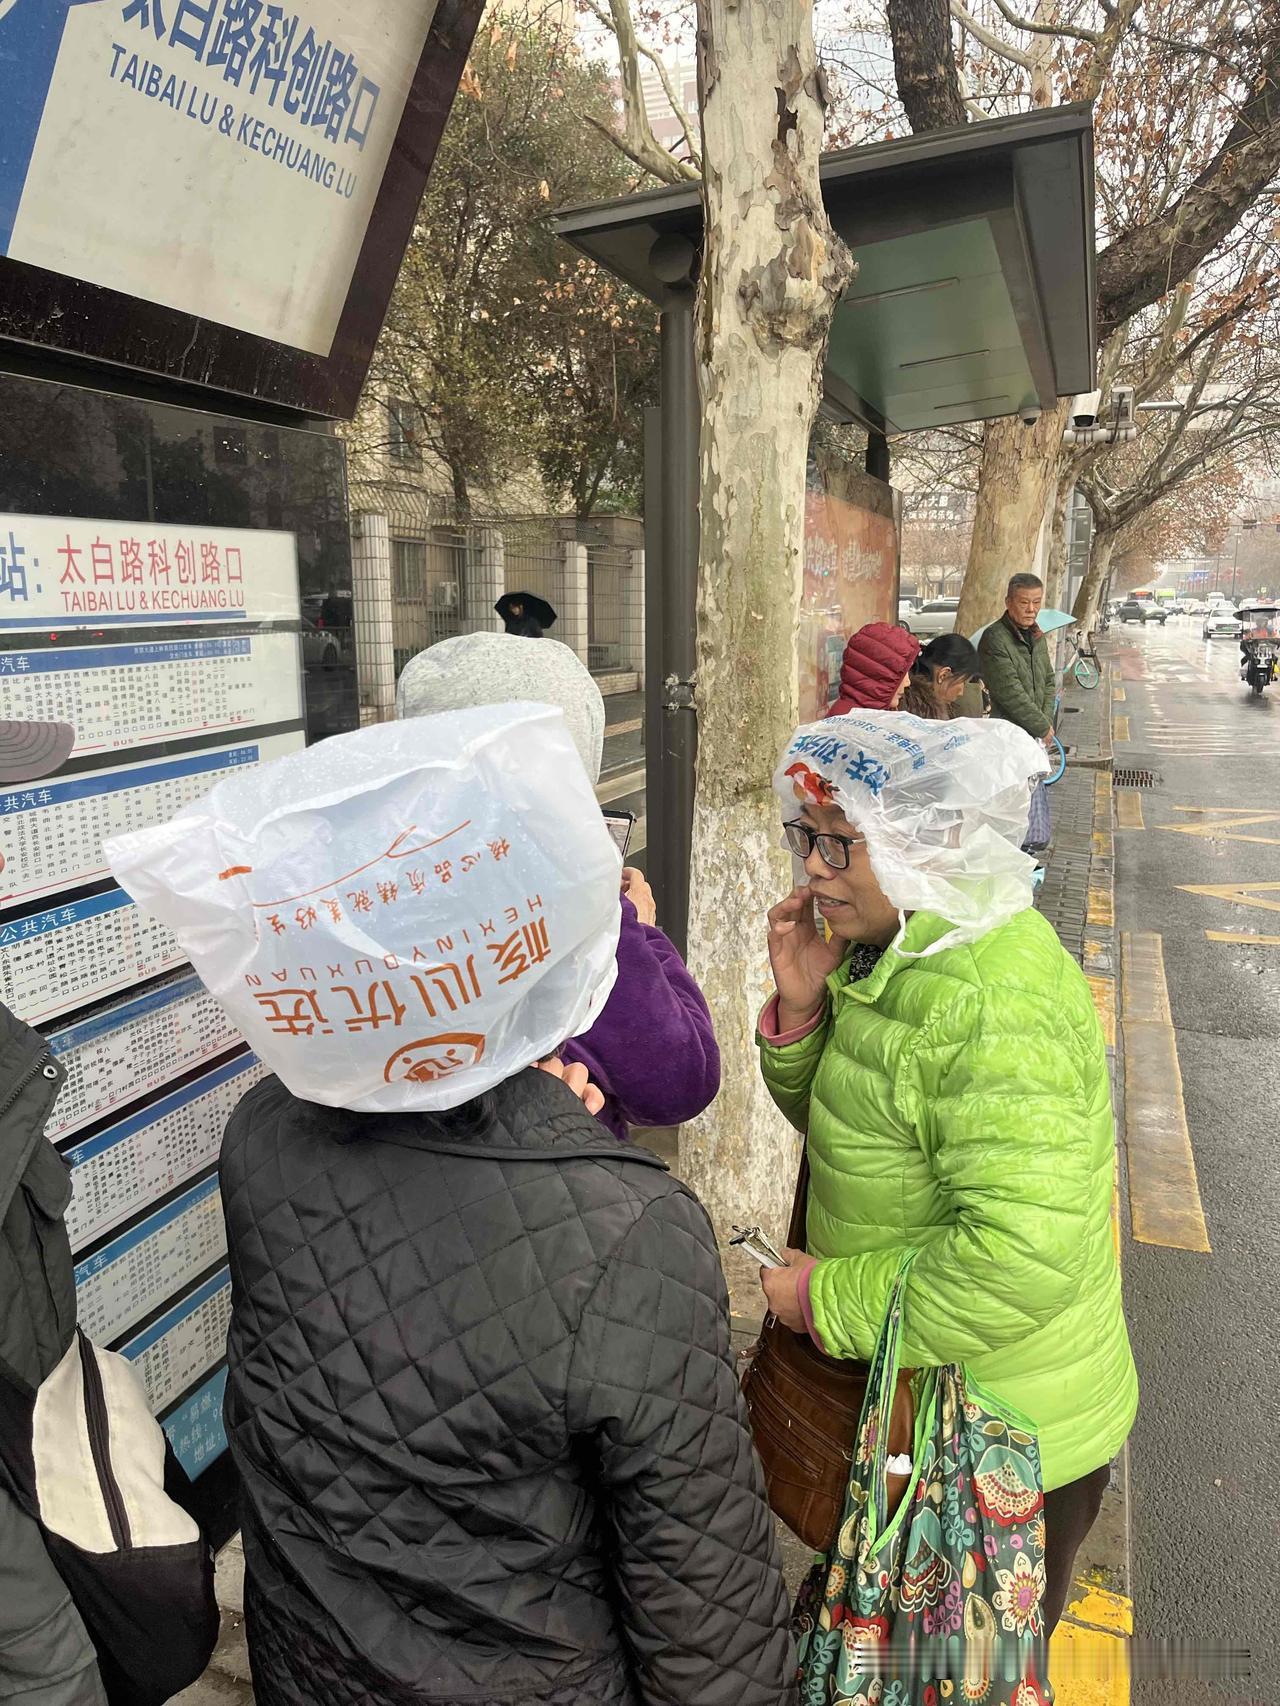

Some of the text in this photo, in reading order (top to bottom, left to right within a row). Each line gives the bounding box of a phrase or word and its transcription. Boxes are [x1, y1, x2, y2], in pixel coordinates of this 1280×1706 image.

[110, 42, 358, 199] TAIBAI LU & KECHUANG LU
[57, 534, 243, 586] 太白路科创路口
[60, 588, 245, 612] TAIBAI LU & KECHUANG LU
[253, 836, 511, 936] 核心品质铸就美好生
[0, 908, 78, 942] 公共汽车
[252, 916, 552, 1036] 核心优选
